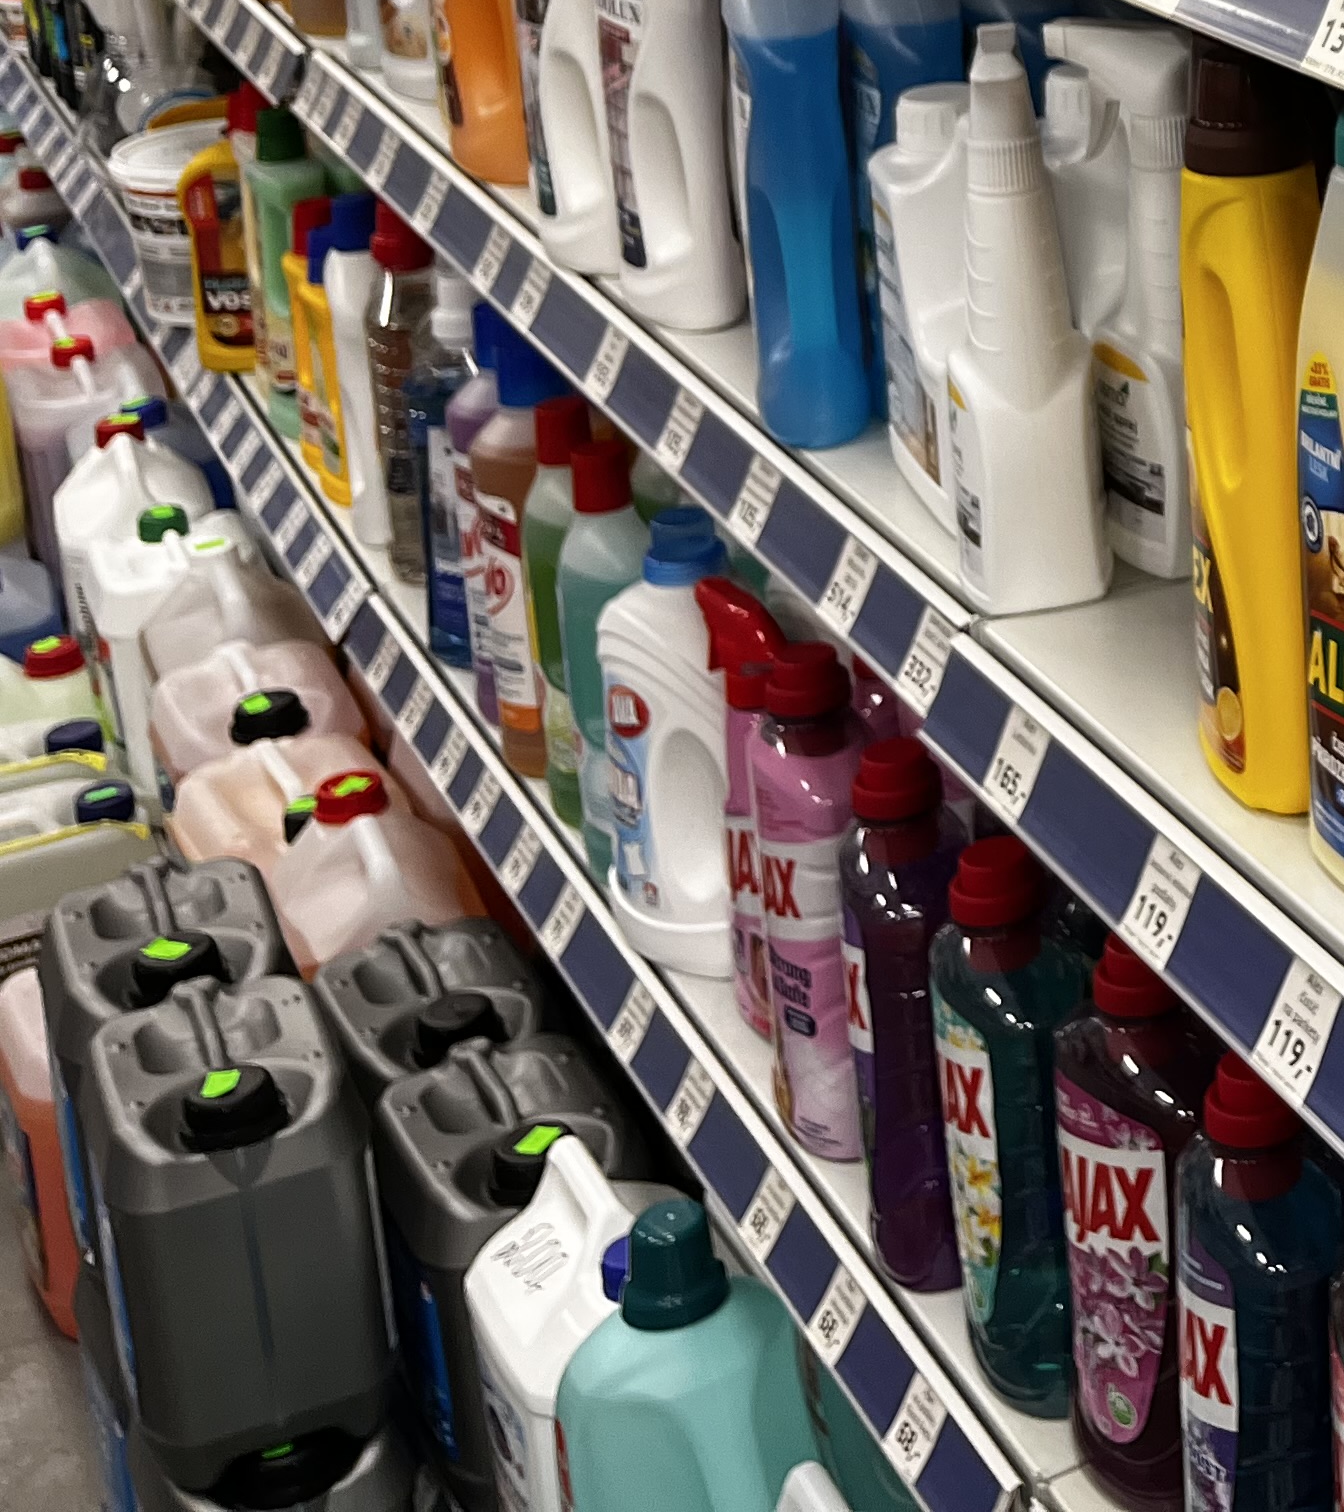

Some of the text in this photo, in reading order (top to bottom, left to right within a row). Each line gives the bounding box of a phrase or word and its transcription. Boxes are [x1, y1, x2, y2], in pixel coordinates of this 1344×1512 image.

[1133, 894, 1173, 949] 119,-
[1267, 1018, 1313, 1079] 119,-
[941, 1058, 991, 1140] AX
[1180, 1307, 1233, 1408] AX
